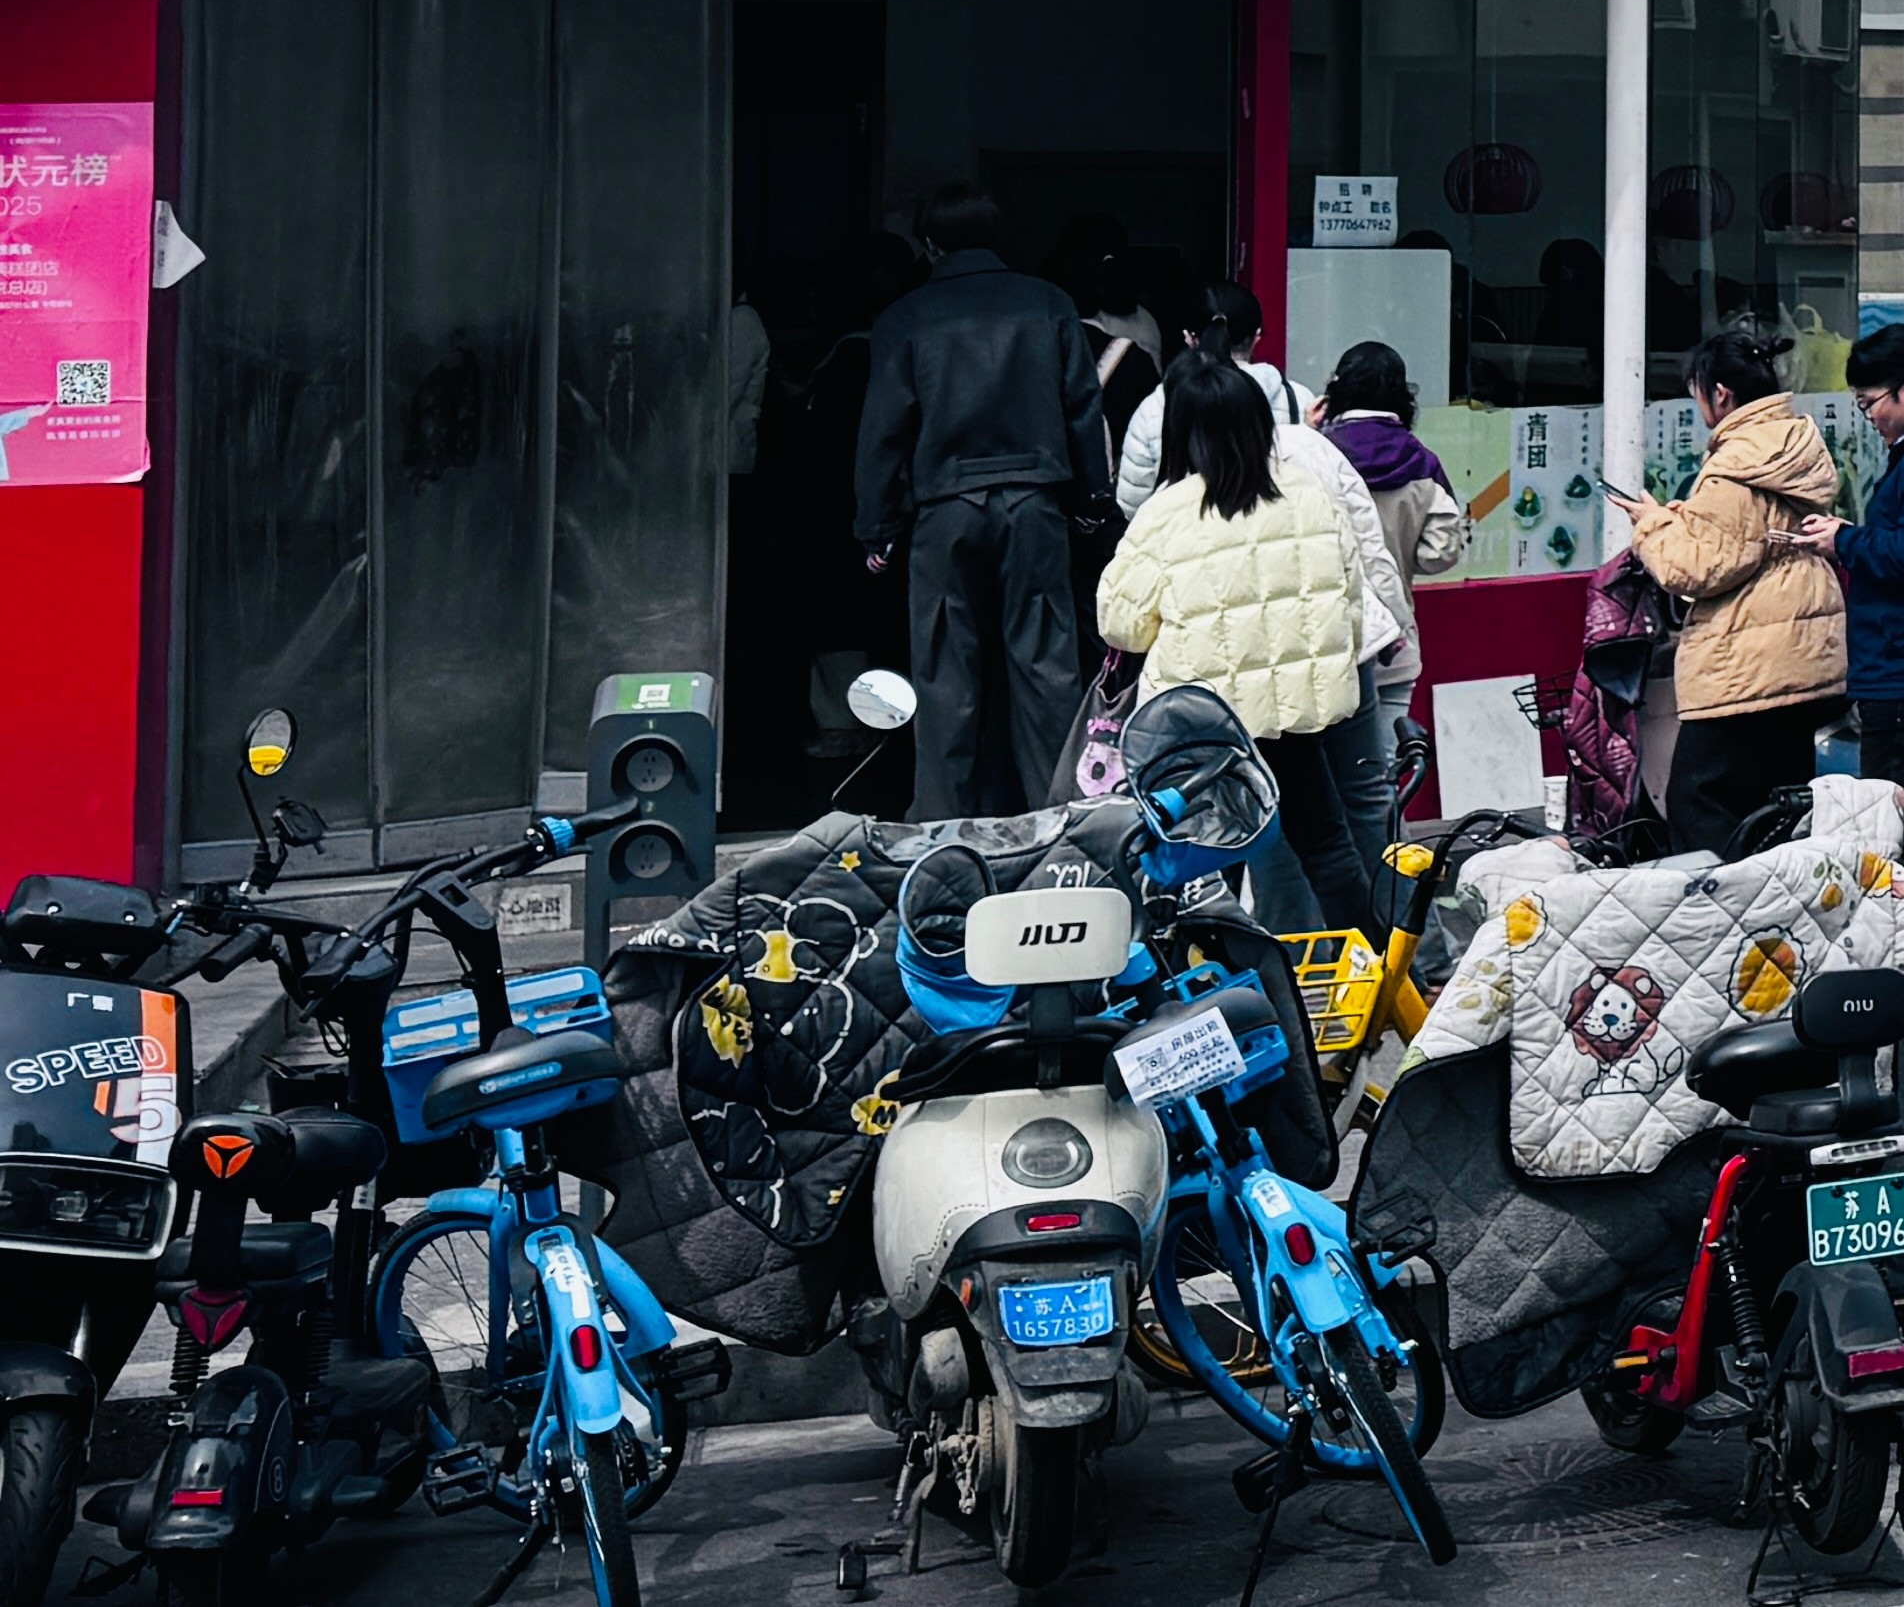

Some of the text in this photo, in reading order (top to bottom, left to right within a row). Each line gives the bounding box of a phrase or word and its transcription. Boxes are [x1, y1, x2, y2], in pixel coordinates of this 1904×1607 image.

[1527, 411, 1548, 469] 青团
[5, 1035, 169, 1093] SPEED
[1012, 1313, 1105, 1338] 1657830
